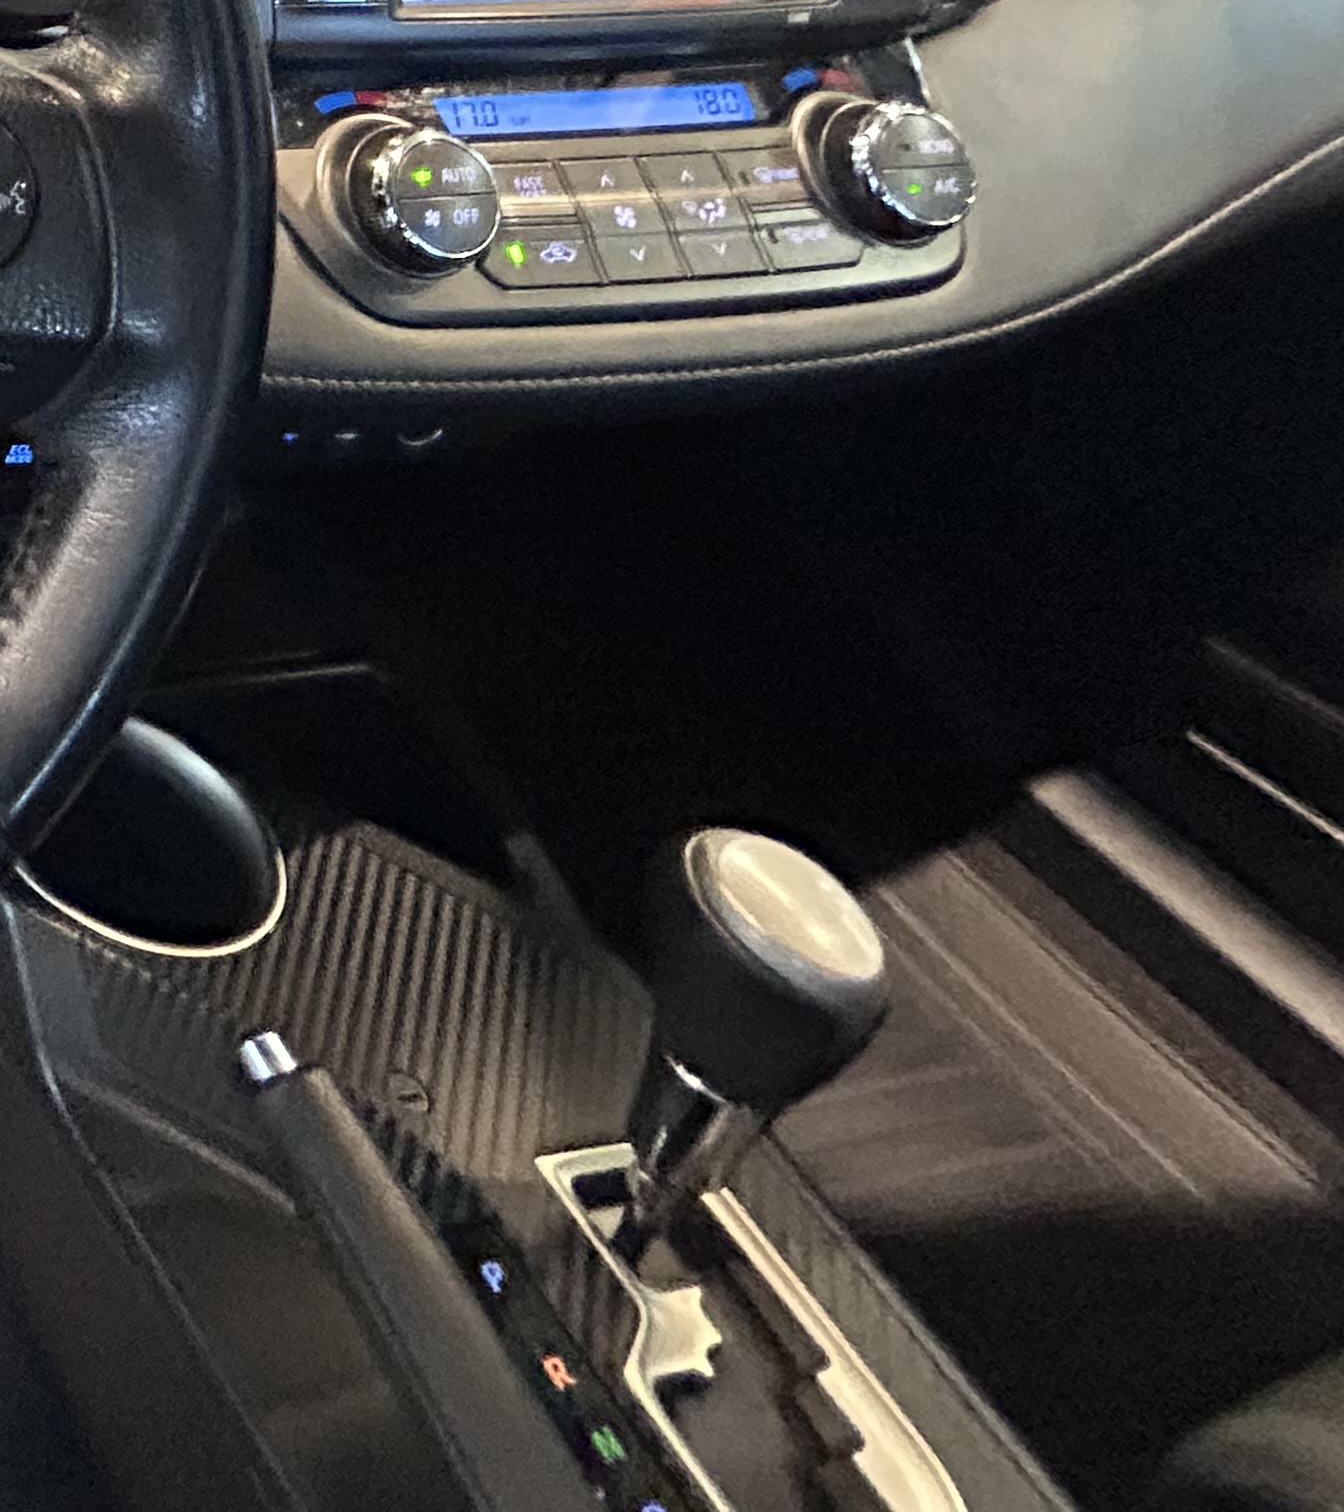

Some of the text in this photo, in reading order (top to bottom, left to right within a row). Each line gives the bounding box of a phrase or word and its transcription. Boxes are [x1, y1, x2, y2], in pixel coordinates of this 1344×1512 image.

[441, 167, 477, 185] AUTO
[452, 208, 480, 225] OFF
[480, 1260, 505, 1293] P
[542, 1355, 576, 1390] R
